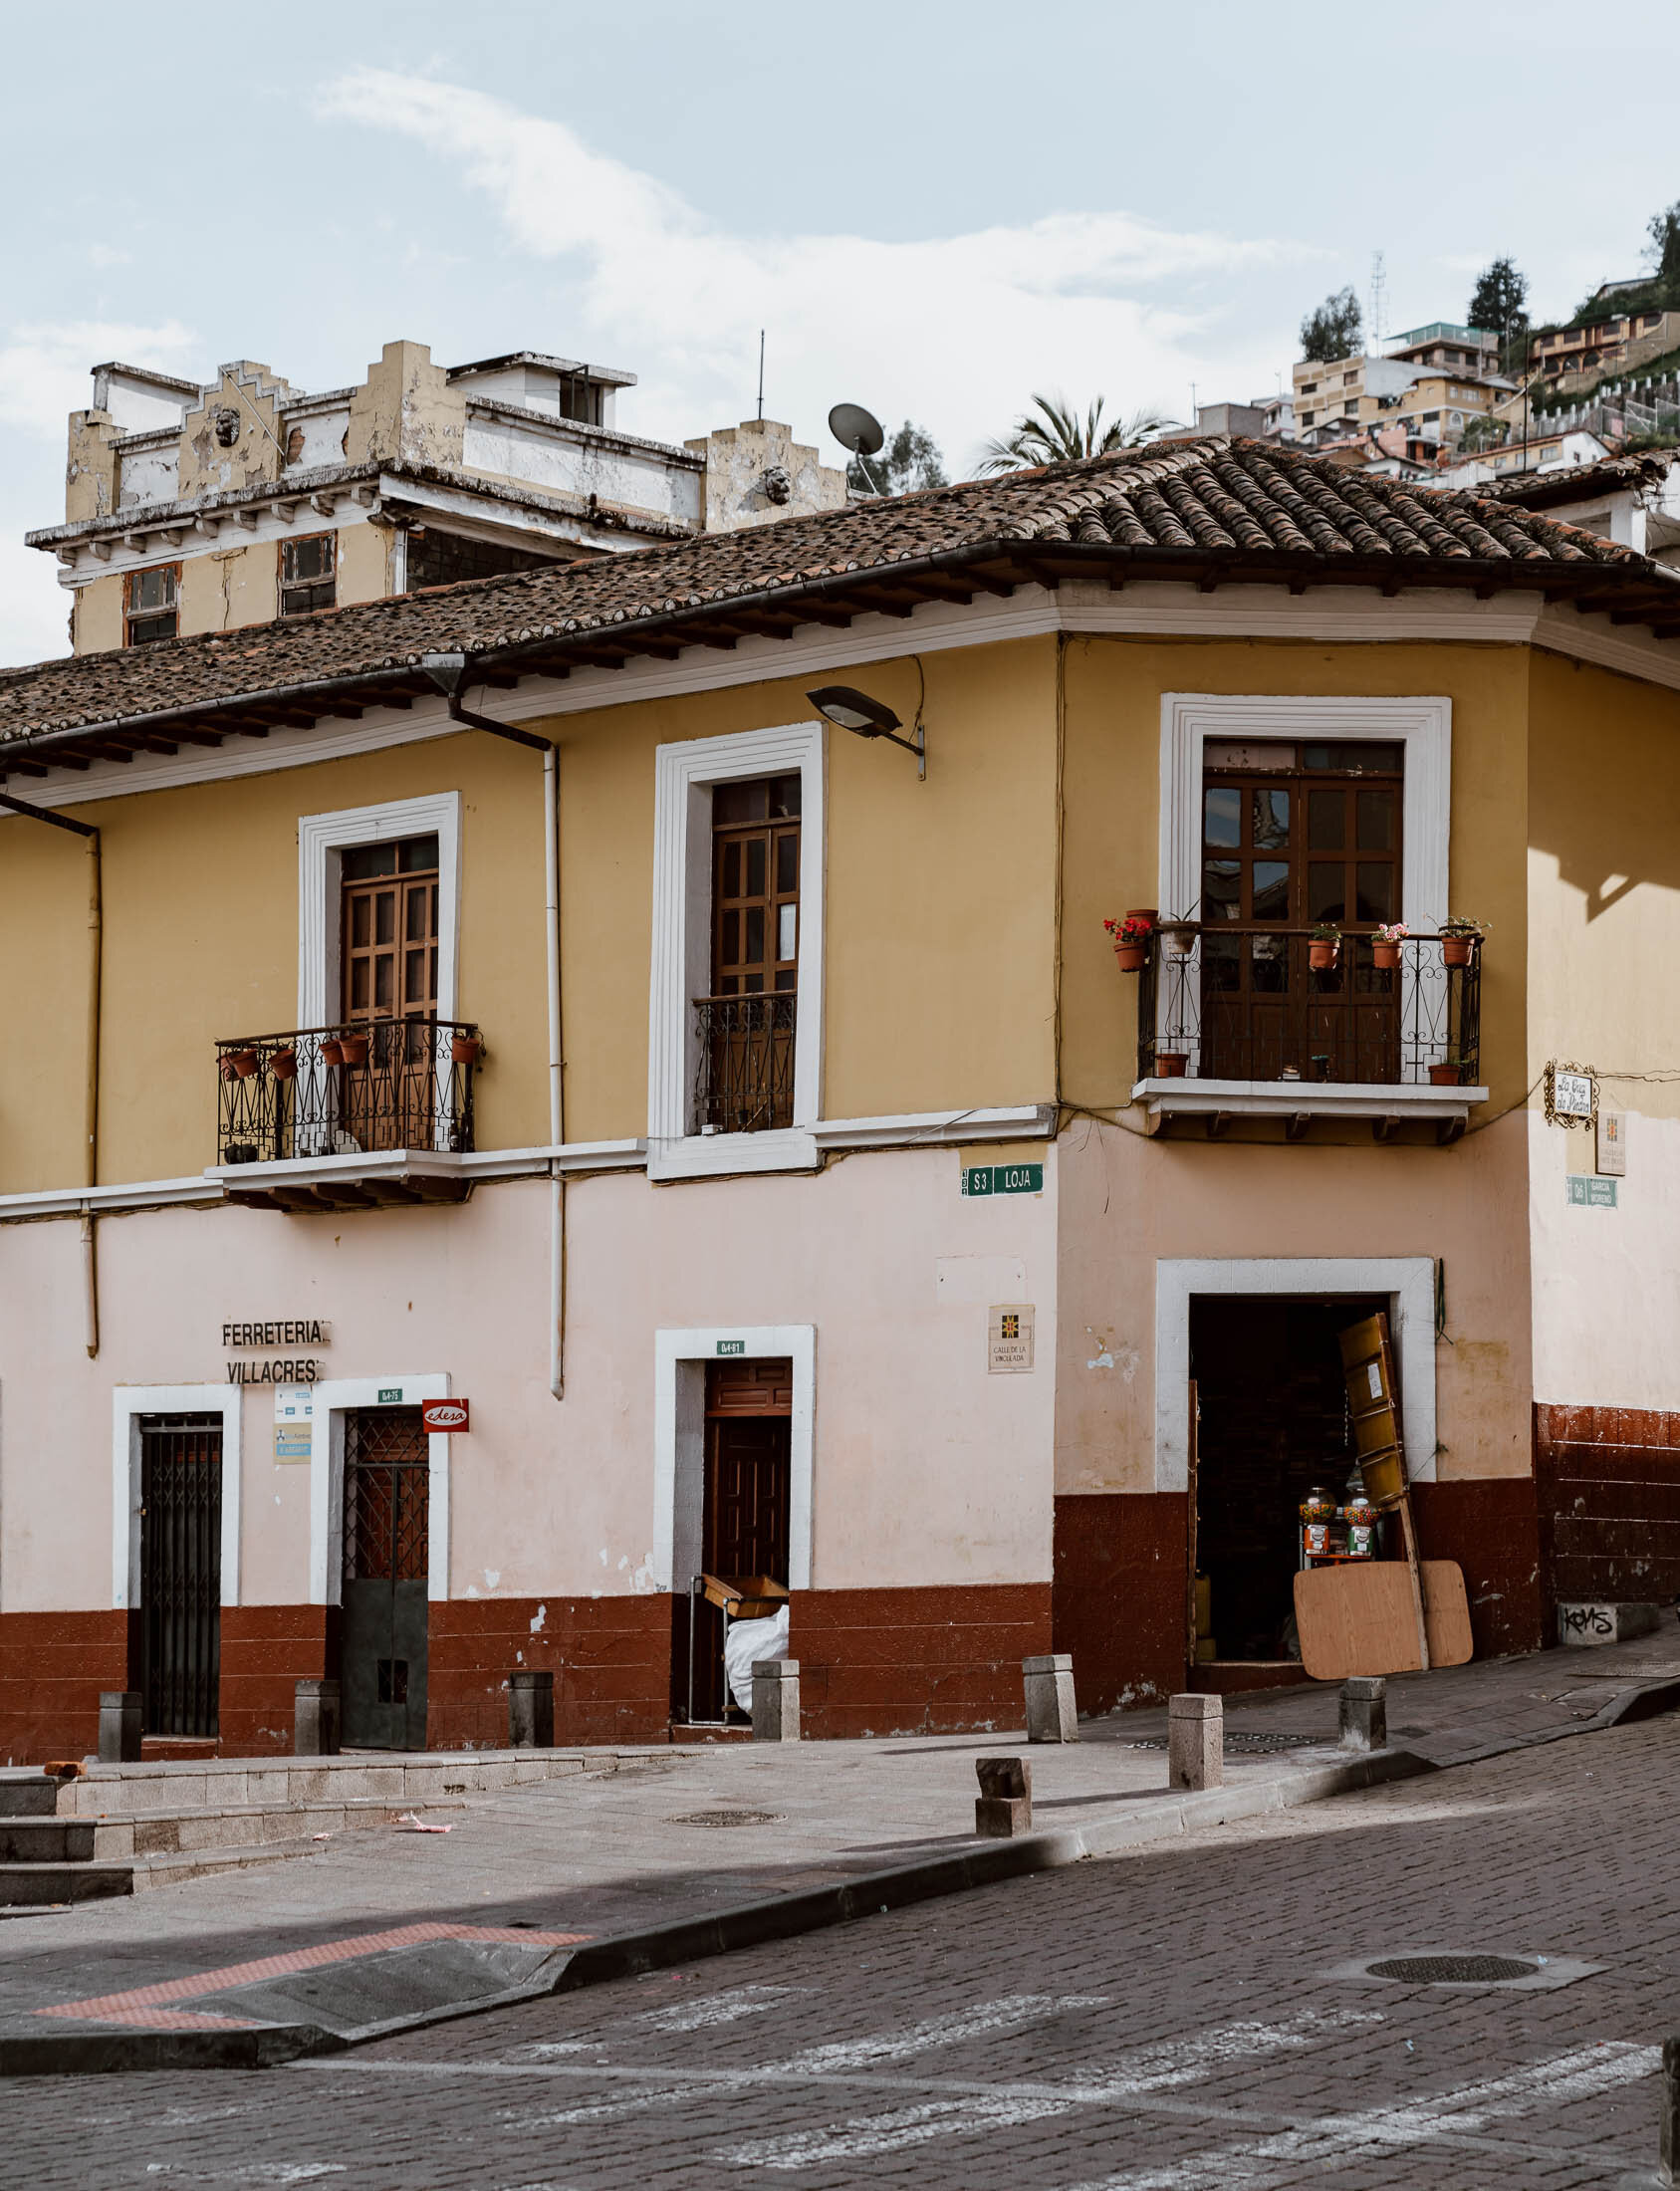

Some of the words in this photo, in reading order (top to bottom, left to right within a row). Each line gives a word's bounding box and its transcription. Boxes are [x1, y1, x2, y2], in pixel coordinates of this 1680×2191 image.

[1005, 1170, 1031, 1188] LOJA
[222, 1320, 322, 1346] FERRETERIA
[227, 1359, 316, 1384] VILLACRES
[425, 1408, 464, 1422] edesa
